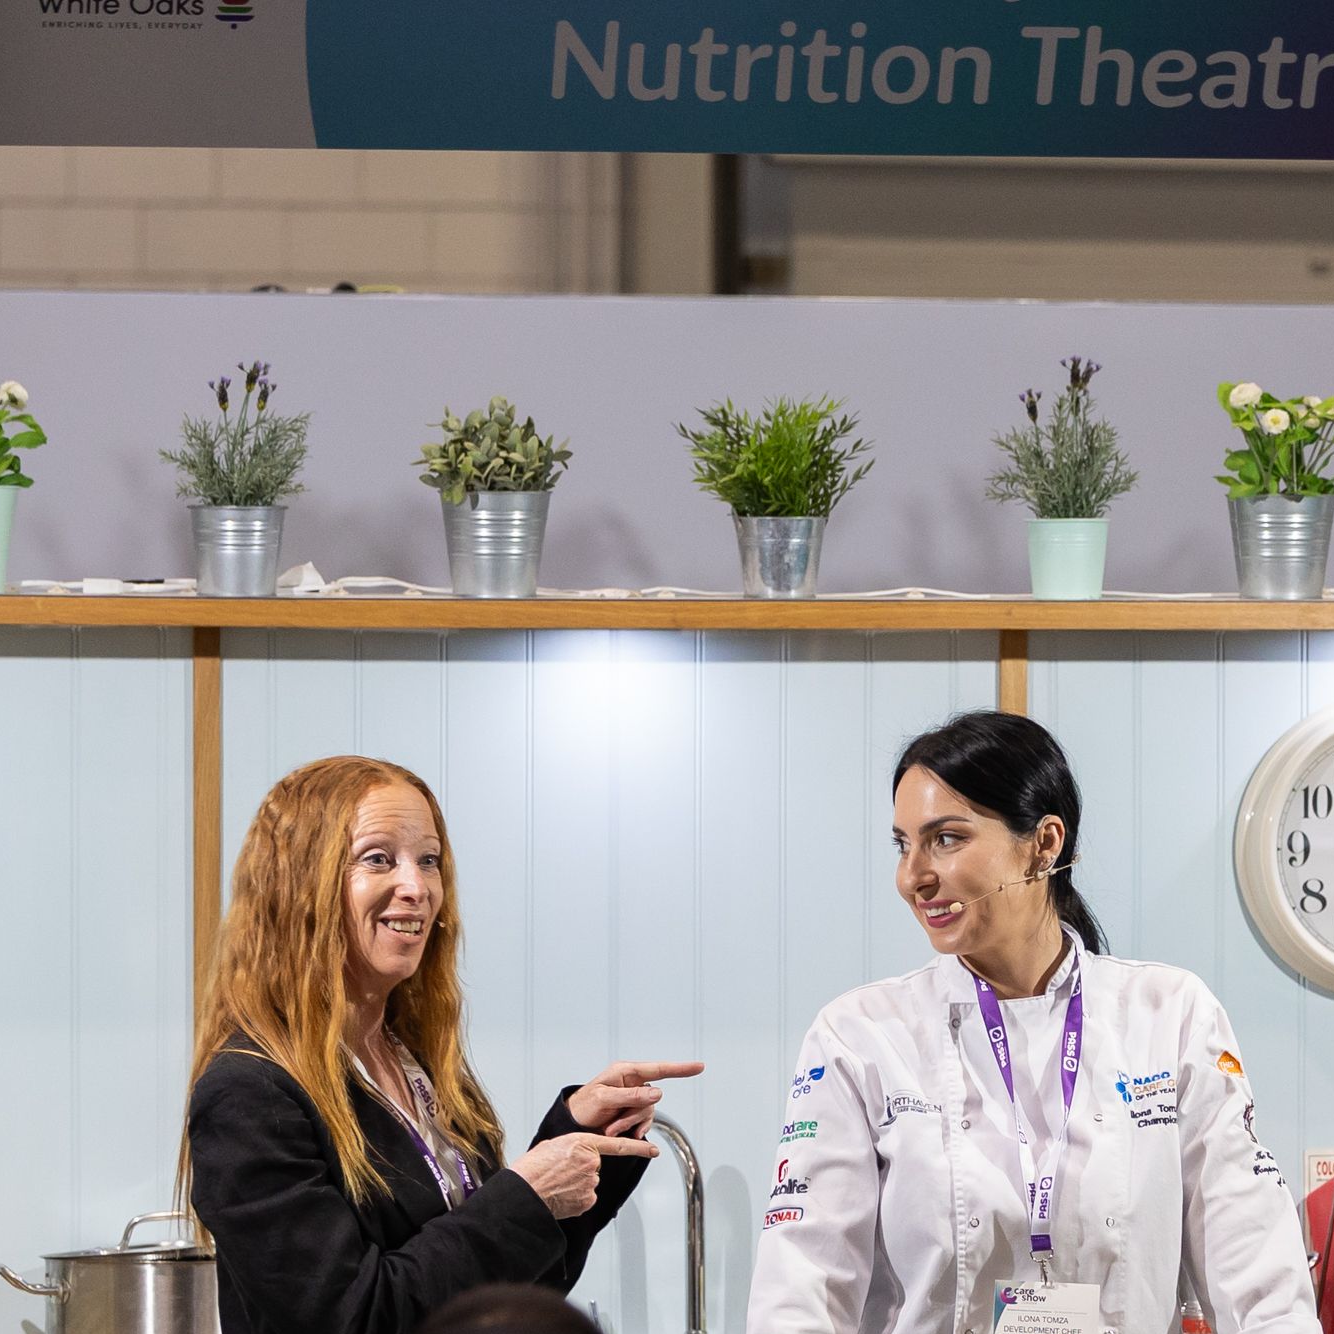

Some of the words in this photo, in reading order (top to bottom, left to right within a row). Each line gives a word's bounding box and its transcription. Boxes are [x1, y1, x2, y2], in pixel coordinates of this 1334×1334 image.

[42, 21, 103, 29] ENRICHING
[108, 22, 142, 30] LIVES,
[147, 22, 203, 30] EVERYDAY
[551, 19, 991, 105] Nutrition
[1303, 784, 1333, 819] 10
[1287, 830, 1311, 867] 9
[1300, 879, 1327, 914] 8
[996, 1041, 1007, 1068] PASS
[1067, 1032, 1077, 1056] PASS
[1138, 1115, 1177, 1128] Champio
[1039, 1192, 1049, 1219] PASS
[1014, 1287, 1035, 1295] care
[1021, 1293, 1046, 1302] show
[1004, 1326, 1059, 1334] DEVELOPMENT
